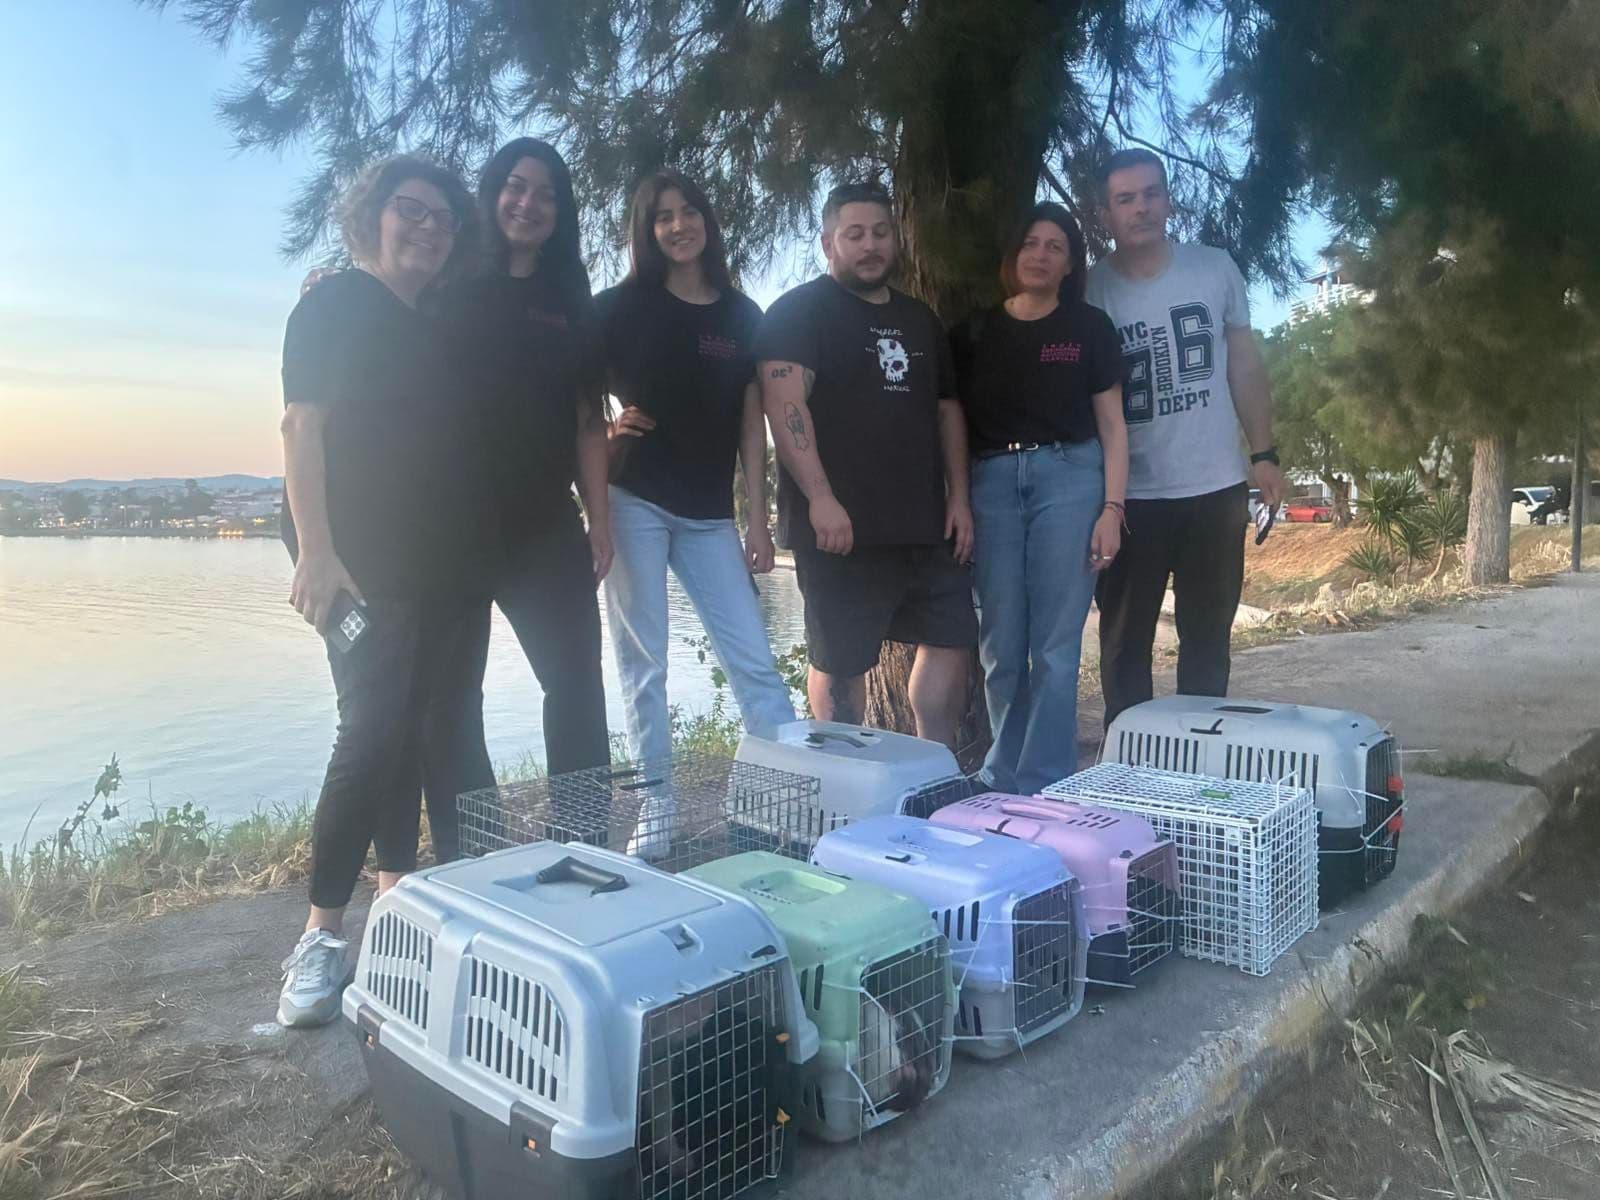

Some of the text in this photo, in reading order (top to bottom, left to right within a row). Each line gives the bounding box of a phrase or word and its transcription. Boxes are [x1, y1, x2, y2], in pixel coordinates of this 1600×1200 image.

[1151, 325, 1173, 393] BROOKLYN
[1169, 301, 1214, 384] 6
[1158, 389, 1210, 417] DEPT
